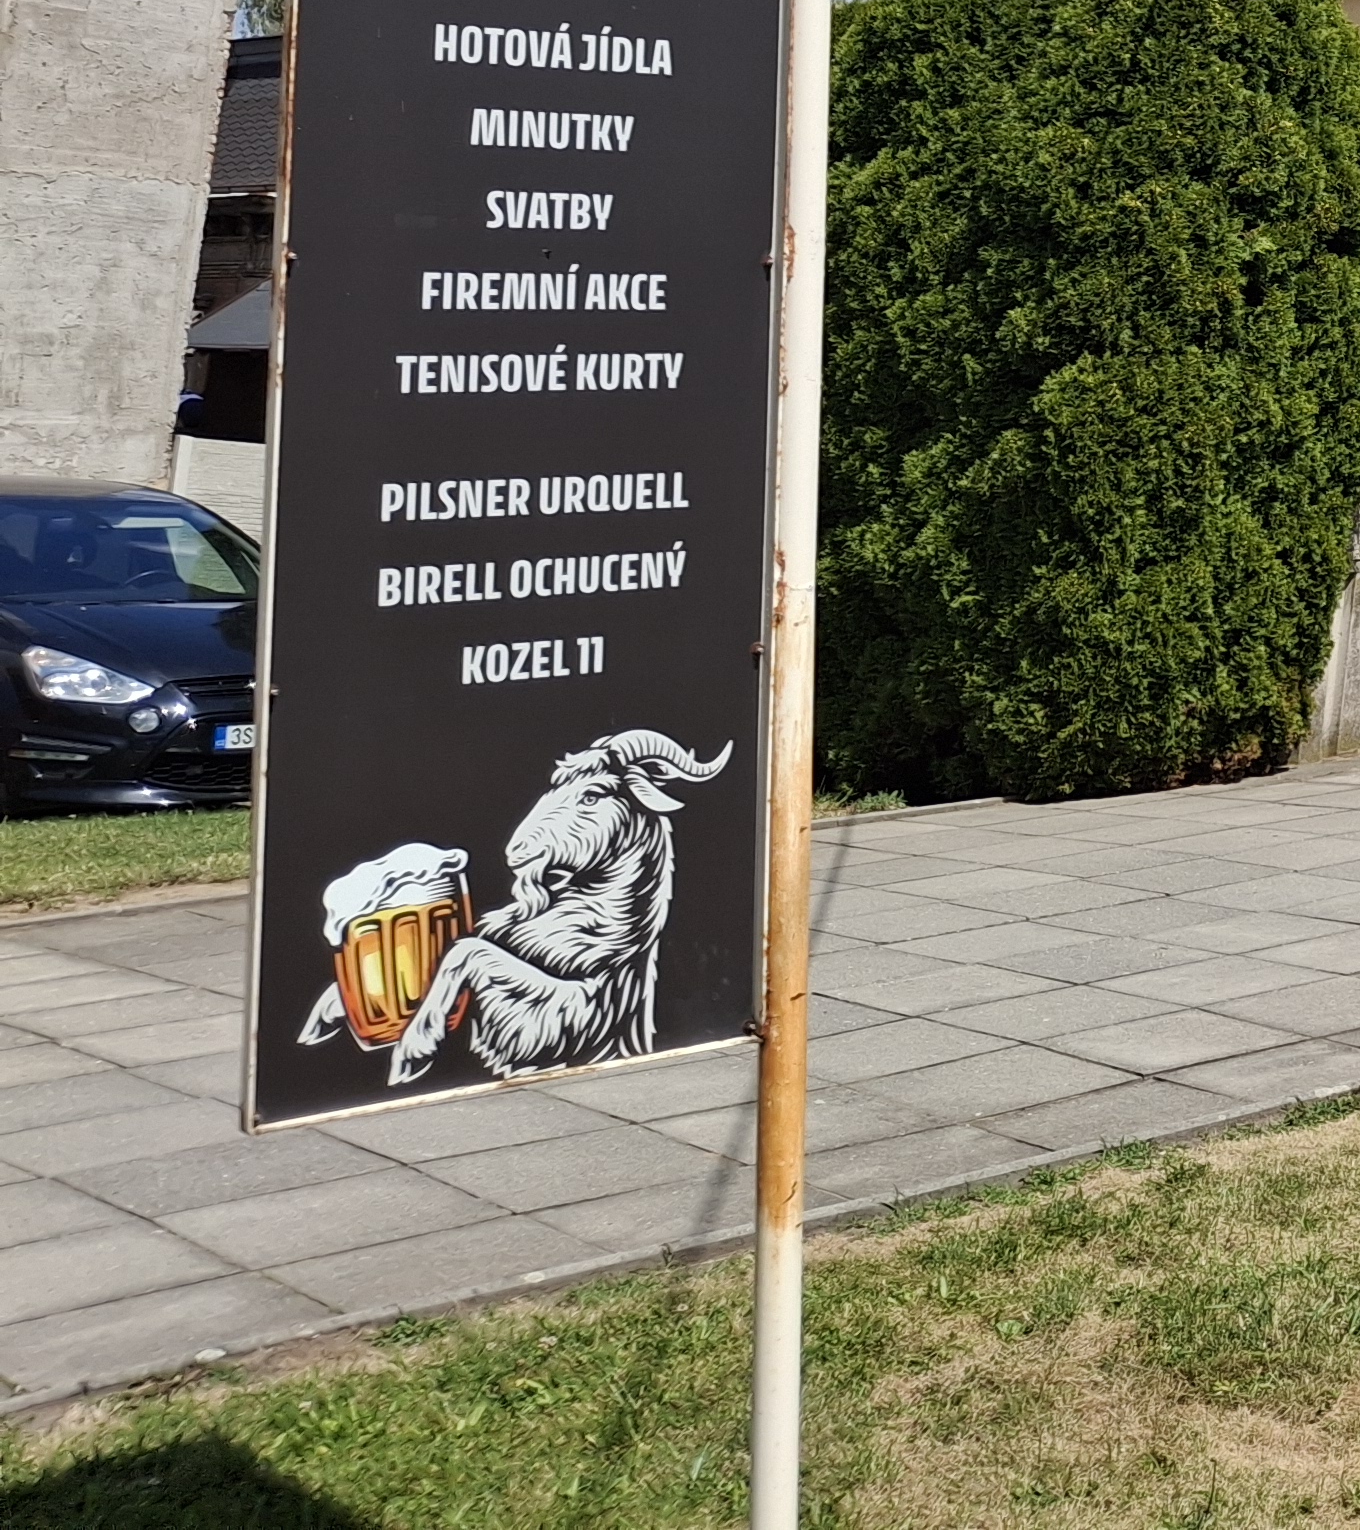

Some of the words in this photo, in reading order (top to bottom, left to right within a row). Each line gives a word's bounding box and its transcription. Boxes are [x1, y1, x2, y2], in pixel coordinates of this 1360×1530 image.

[434, 22, 573, 70] HOTOVÁ
[578, 25, 673, 76] JÍDLA
[470, 108, 635, 152] MINUTKY
[486, 190, 614, 231] SVATBY
[421, 263, 580, 310] FIREMNÍ
[584, 273, 667, 311] AKCE
[395, 344, 568, 394] TENISOVÉ
[576, 352, 684, 391] KURTY
[380, 478, 531, 522] PILSNER
[539, 471, 689, 515] URQUELL
[377, 562, 502, 607] BIRELL
[509, 540, 687, 599] OCHUCENÝ
[461, 639, 570, 685] KOZEL
[576, 636, 604, 675] 11
